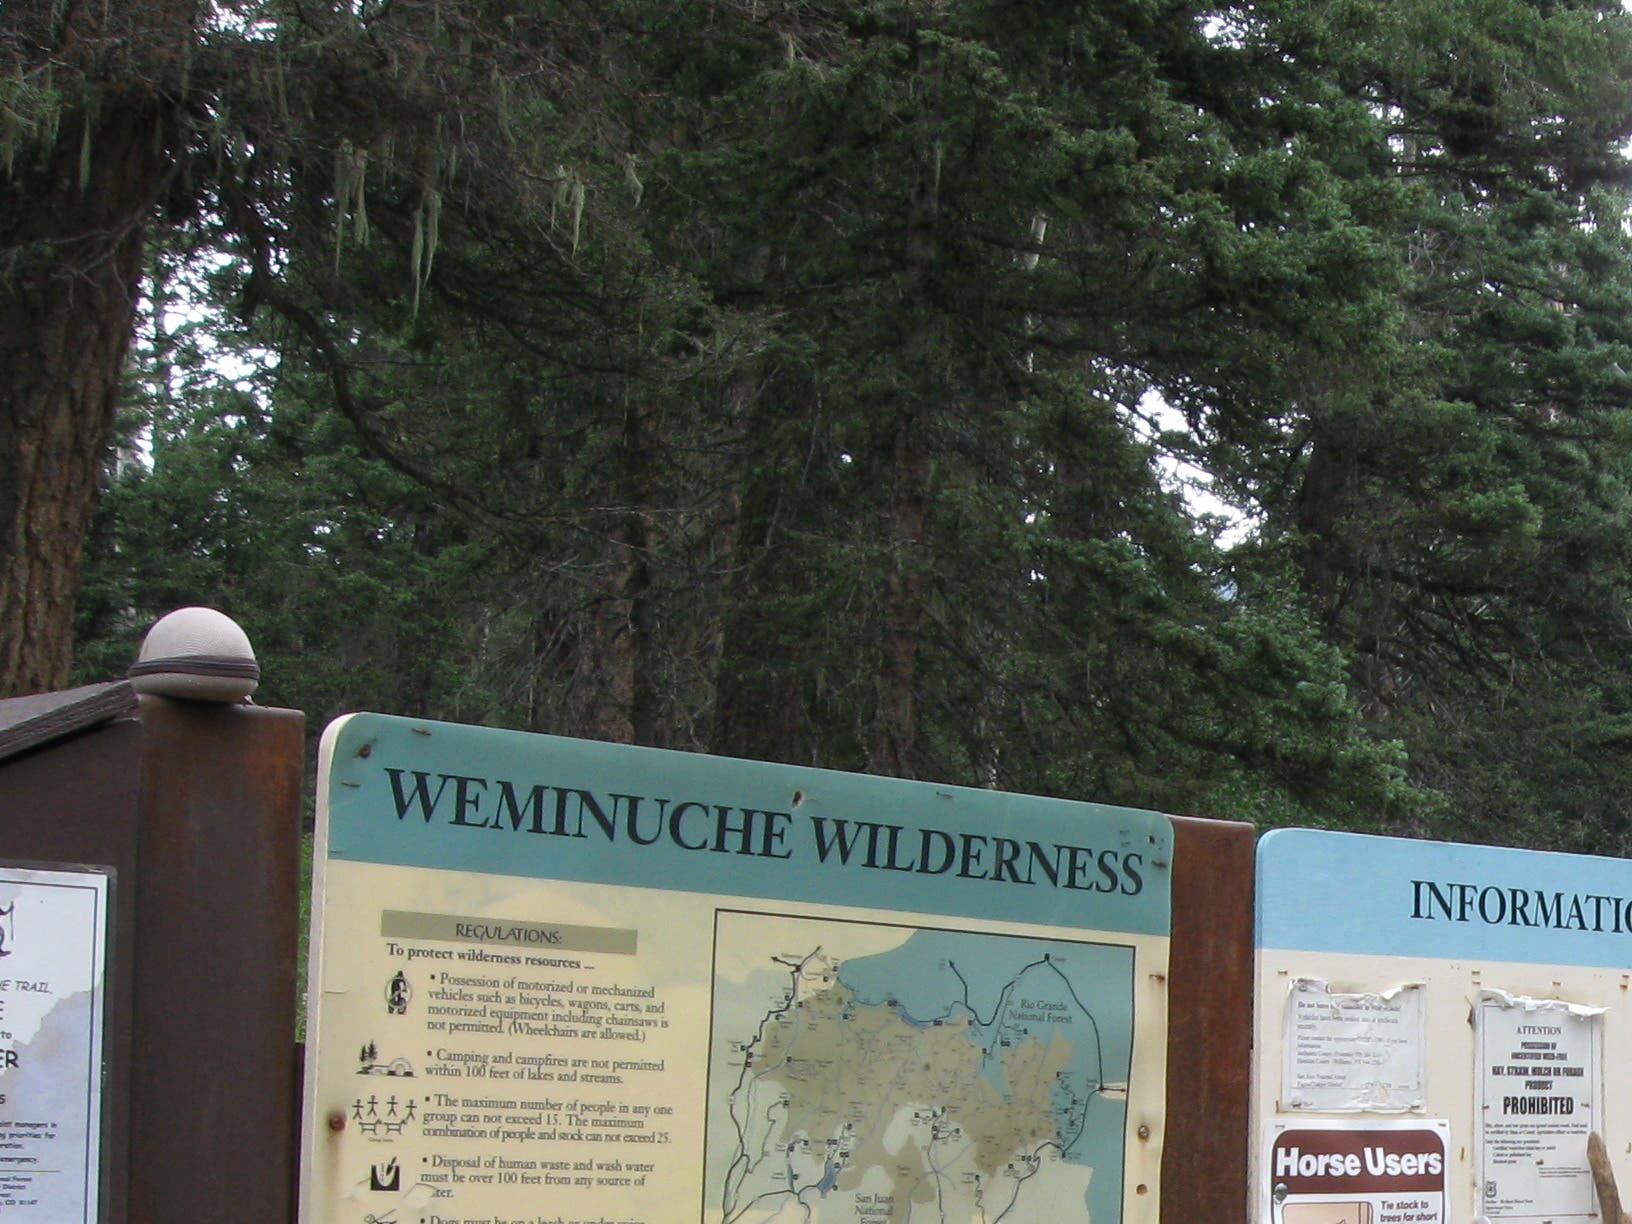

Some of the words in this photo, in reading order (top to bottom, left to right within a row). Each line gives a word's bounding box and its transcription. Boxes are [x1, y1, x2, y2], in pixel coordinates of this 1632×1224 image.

[384, 768, 793, 860] WEMINUCHE
[810, 816, 1143, 896] WILDERNESS
[455, 923, 562, 945] REGULATIONS:
[386, 943, 404, 956] To
[407, 946, 453, 961] protect
[457, 949, 522, 965] wilderness
[524, 956, 582, 969] resources
[1516, 1025, 1562, 1035] ATTENTION
[1503, 1096, 1574, 1115] PROHIBITED
[1275, 1147, 1362, 1177] Horse
[1363, 1147, 1443, 1176] Users
[1381, 1200, 1394, 1209] Tie
[1396, 1200, 1418, 1209] stock
[1420, 1200, 1429, 1209] to
[1380, 1213, 1401, 1222] trees
[1402, 1212, 1415, 1221] for
[1416, 1212, 1438, 1221] short
